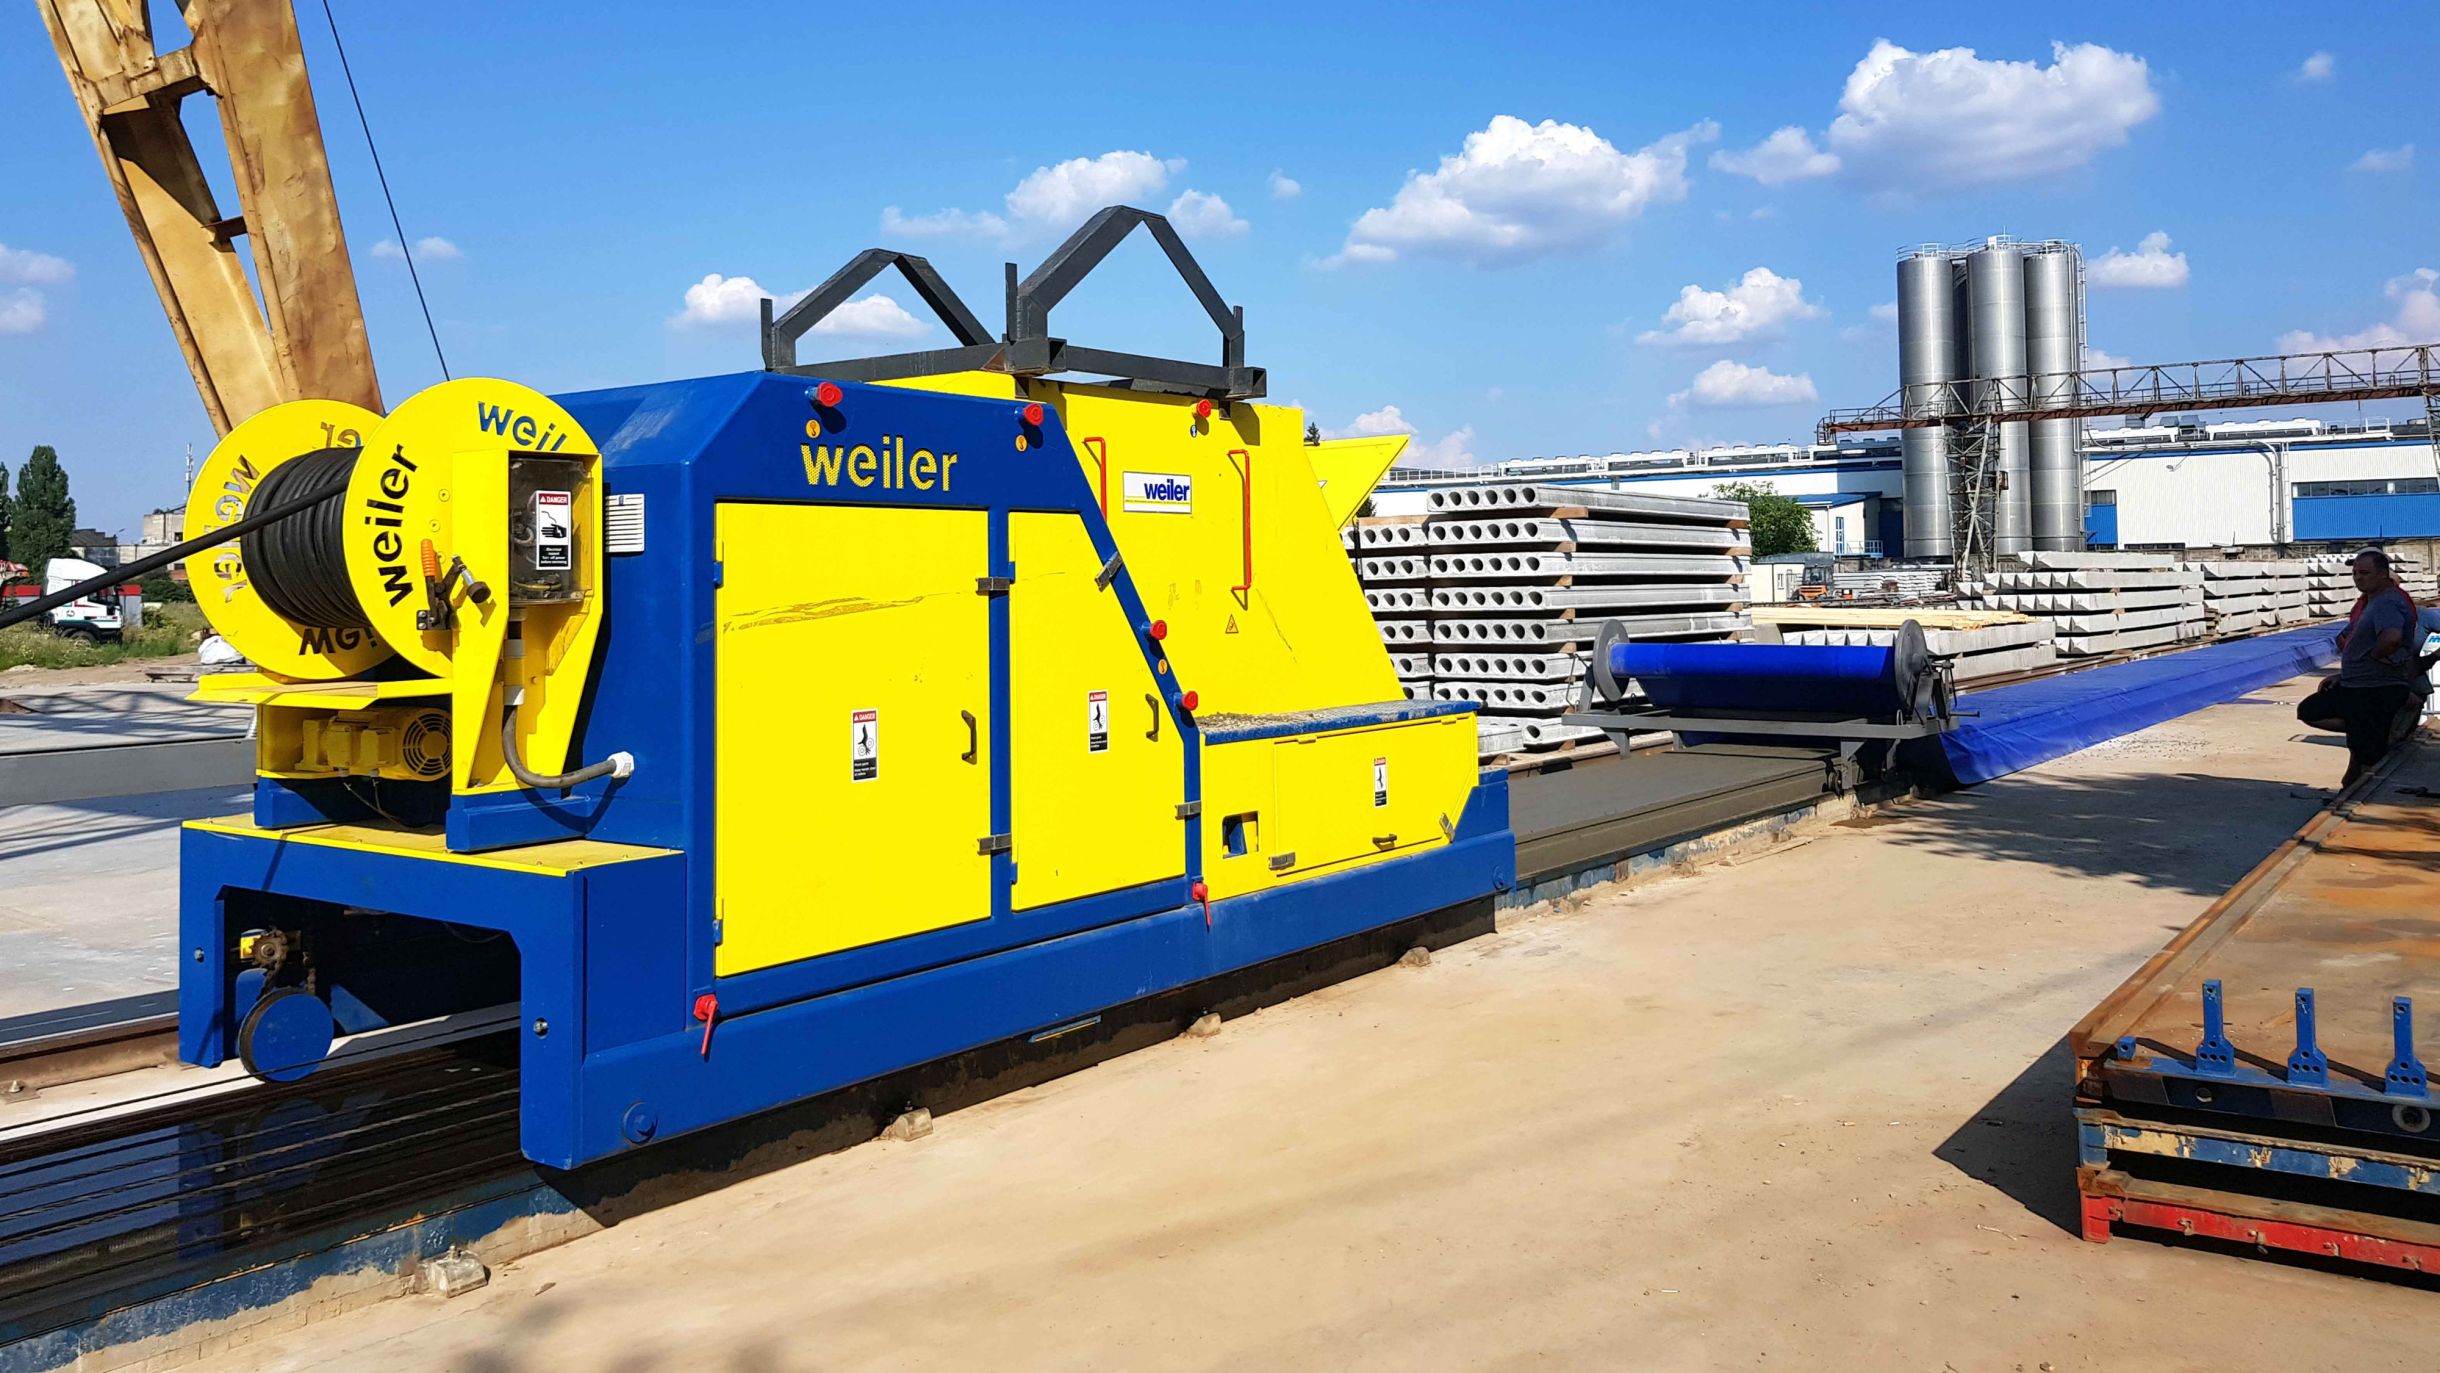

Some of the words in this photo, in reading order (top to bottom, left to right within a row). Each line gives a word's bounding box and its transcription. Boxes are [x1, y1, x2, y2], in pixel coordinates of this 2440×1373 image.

[801, 433, 958, 492] weiler
[546, 496, 568, 504] DANGER
[1144, 478, 1190, 502] weiler
[364, 443, 418, 608] weiler
